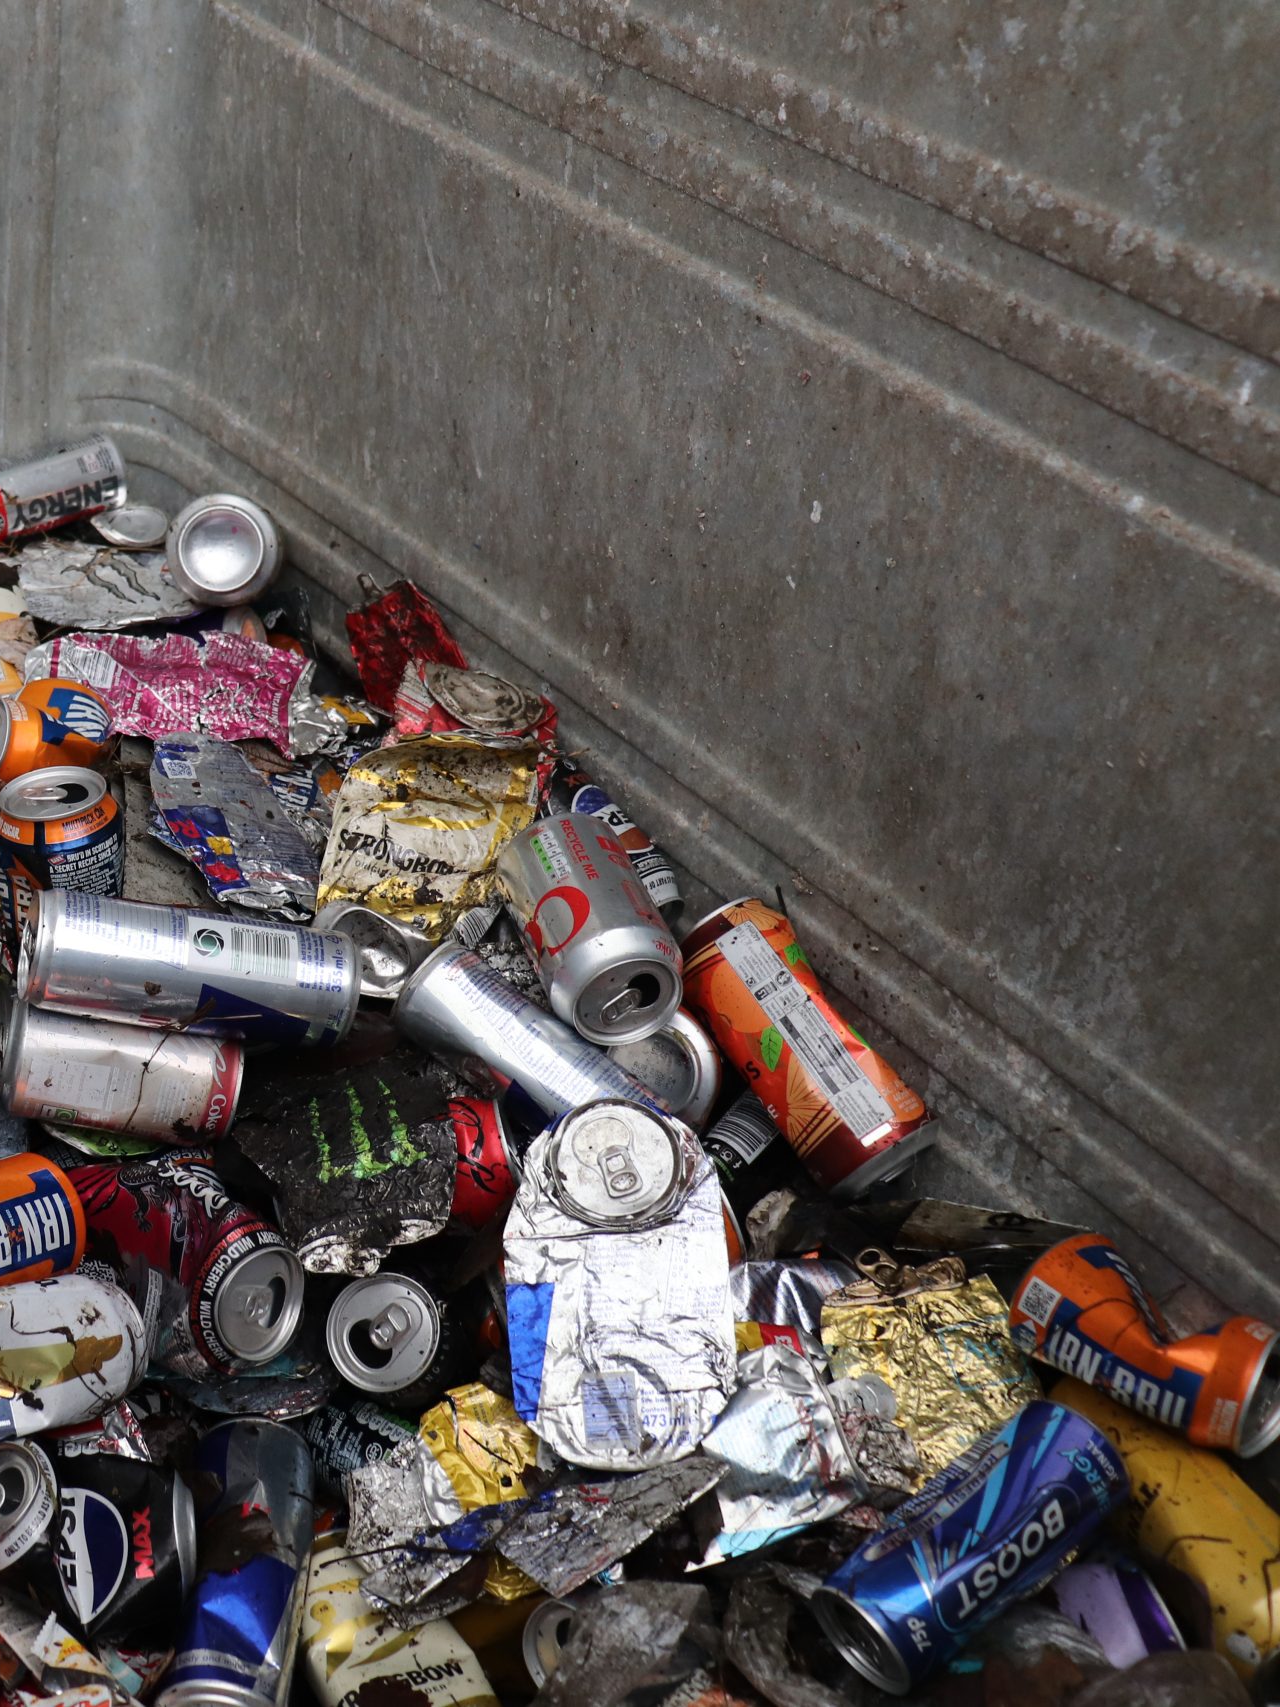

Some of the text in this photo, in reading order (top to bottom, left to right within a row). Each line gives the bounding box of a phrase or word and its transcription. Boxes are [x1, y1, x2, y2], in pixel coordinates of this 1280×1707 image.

[13, 476, 119, 530] ENERGY
[68, 694, 111, 741] IRN
[54, 862, 77, 874] SECRET
[77, 856, 97, 868] RECIPE
[84, 848, 91, 856] IN
[559, 819, 600, 881] RECYCLE ME
[205, 1093, 228, 1131] Coke
[16, 1192, 71, 1260] IRN
[1047, 1323, 1103, 1385] IRN
[1112, 1365, 1187, 1429] BRU
[641, 1413, 668, 1427] 473
[3, 1539, 22, 1558] ONLY
[17, 1533, 29, 1545] TO
[58, 1497, 78, 1588] EPSI
[131, 1505, 156, 1580] MAX
[956, 1497, 1067, 1621] BOOST
[904, 1613, 934, 1654] 75p
